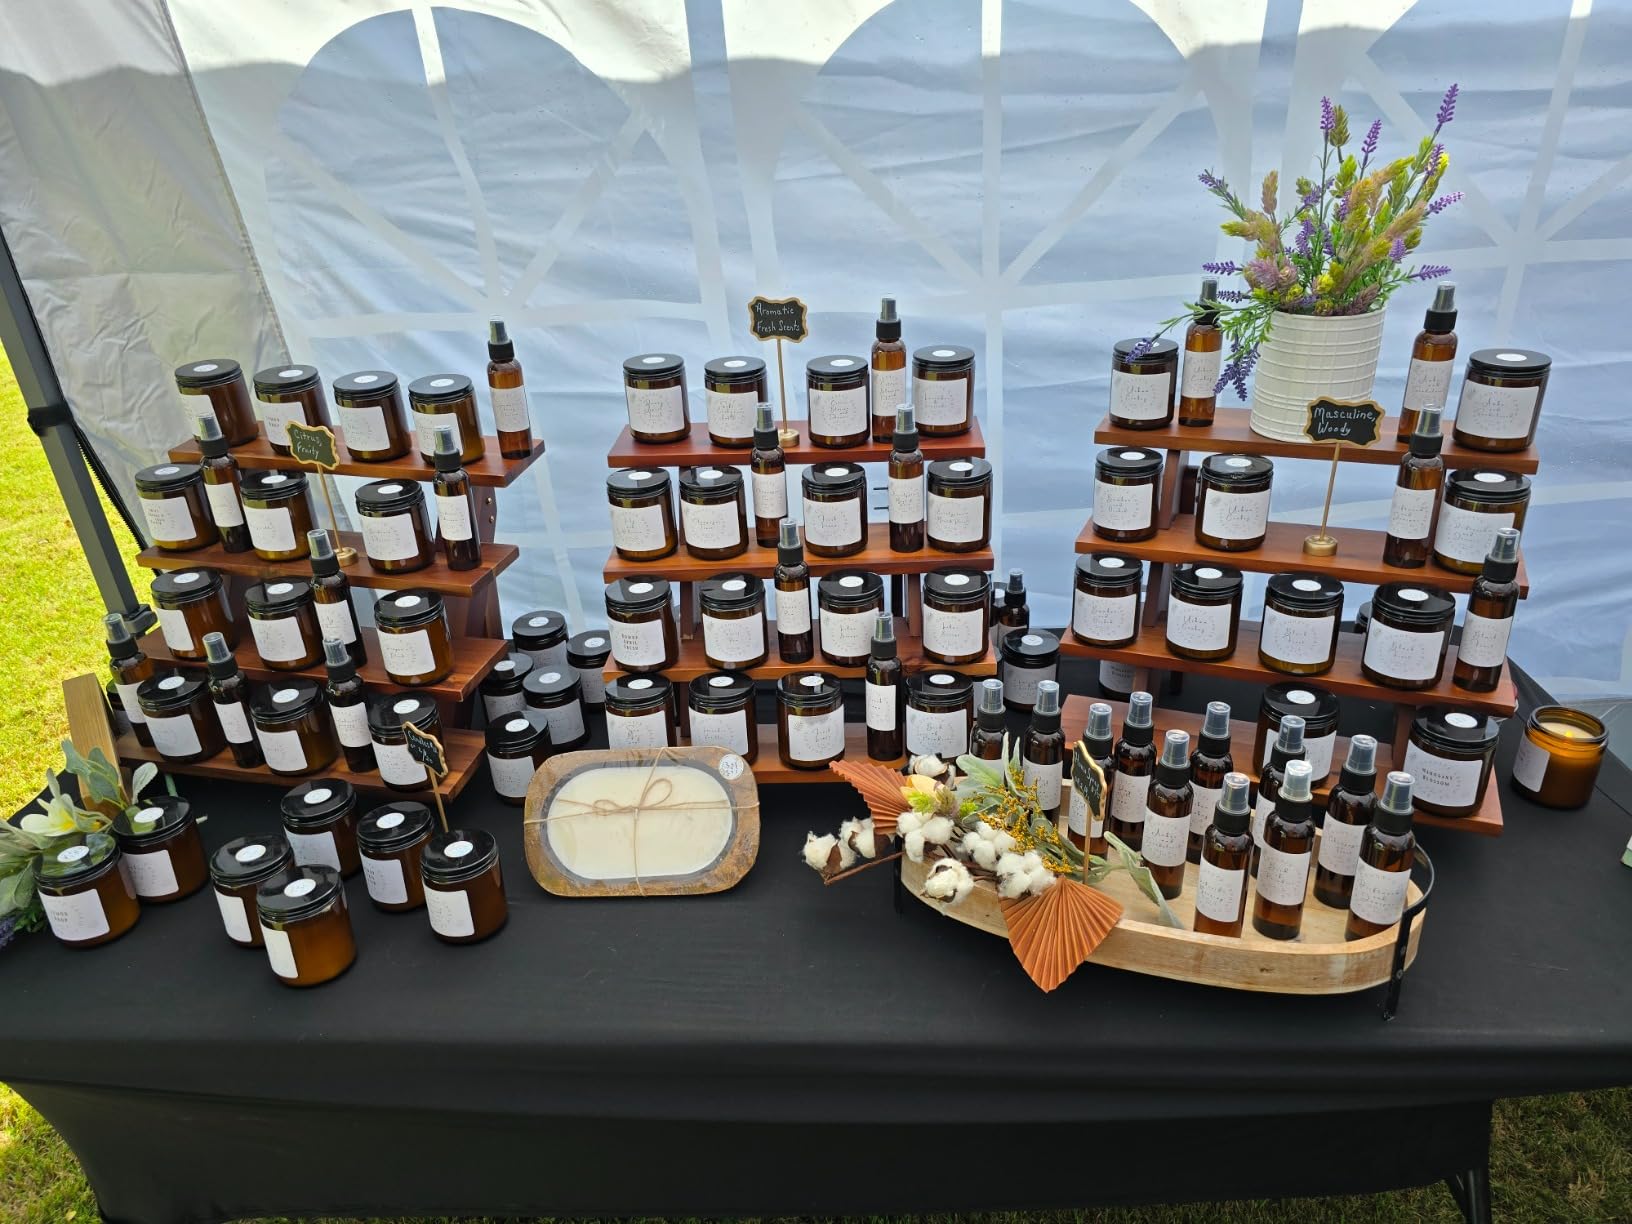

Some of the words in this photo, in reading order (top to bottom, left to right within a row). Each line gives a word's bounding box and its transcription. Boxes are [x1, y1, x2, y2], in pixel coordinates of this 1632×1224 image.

[755, 302, 795, 316] Aromatic
[757, 320, 776, 333] Fresh
[1313, 407, 1376, 424] Masculine,
[1317, 421, 1351, 436] Woody
